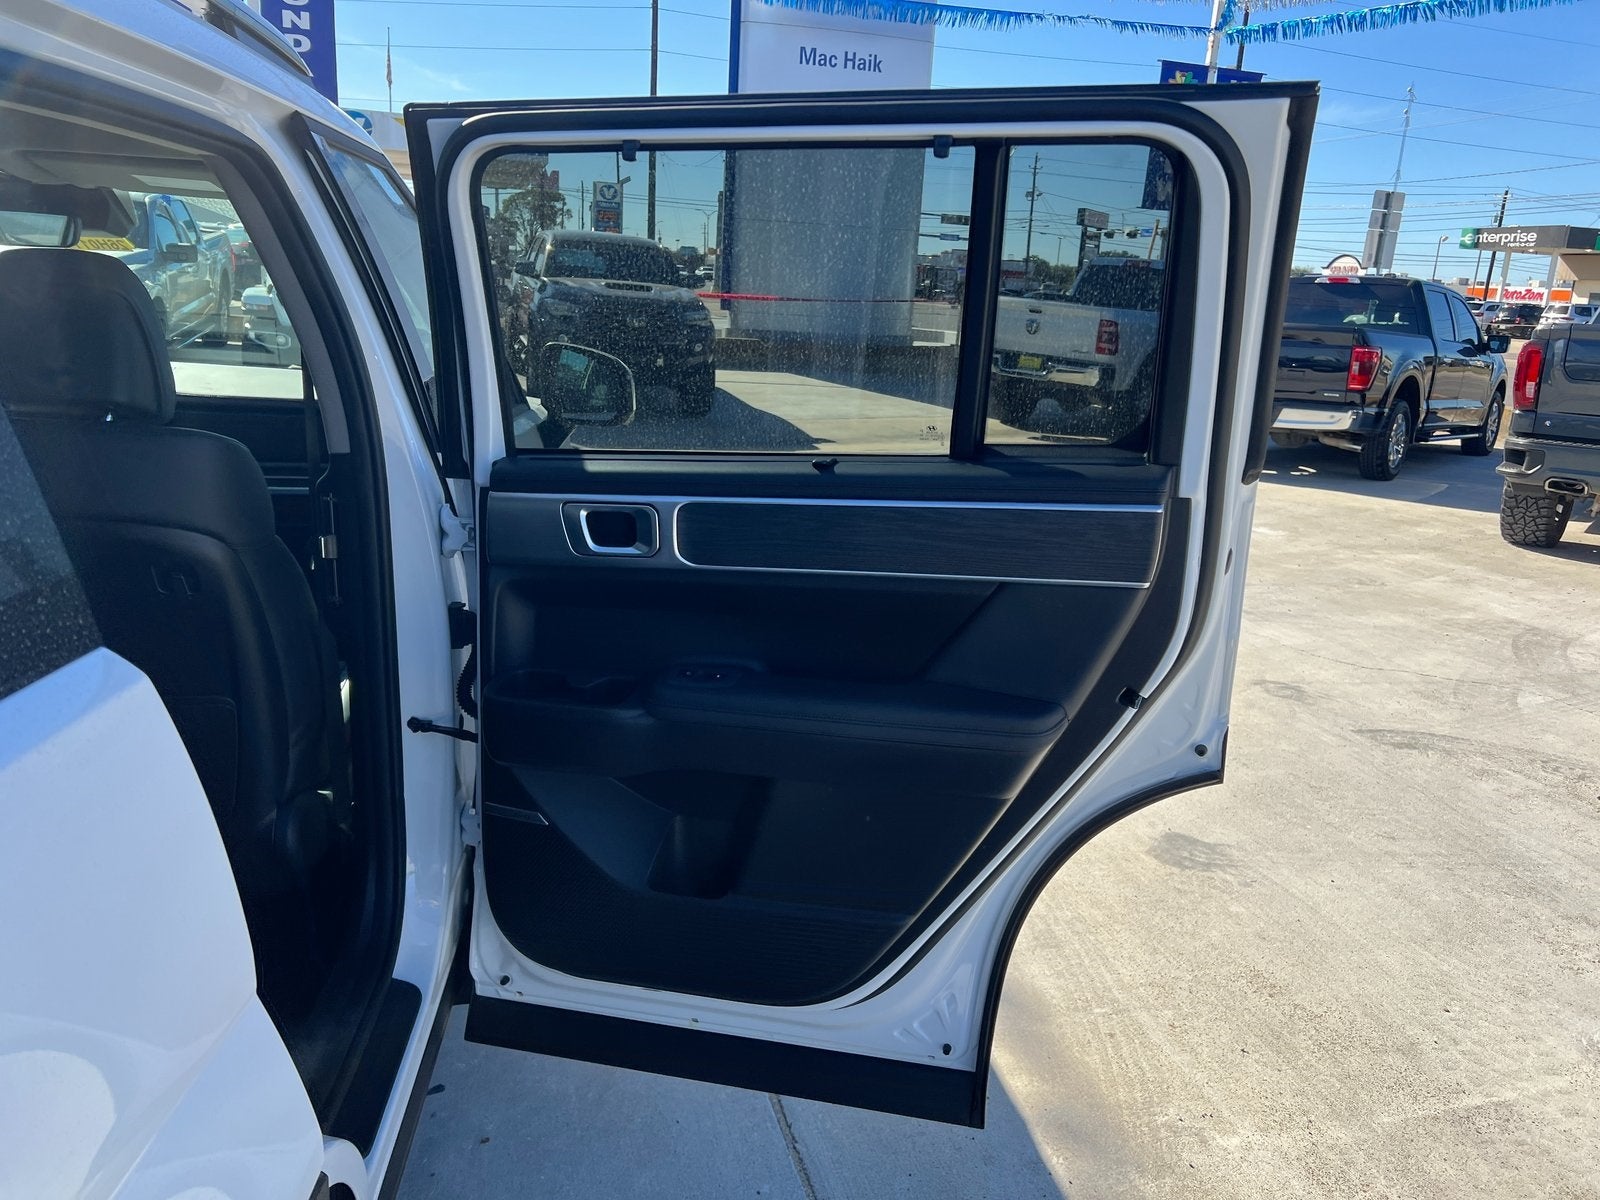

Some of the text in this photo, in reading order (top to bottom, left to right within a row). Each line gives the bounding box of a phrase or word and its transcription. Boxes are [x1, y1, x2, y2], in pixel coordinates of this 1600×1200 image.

[282, 0, 311, 53] ND
[799, 46, 882, 73] Mac Haik
[1460, 230, 1538, 246] enterprise
